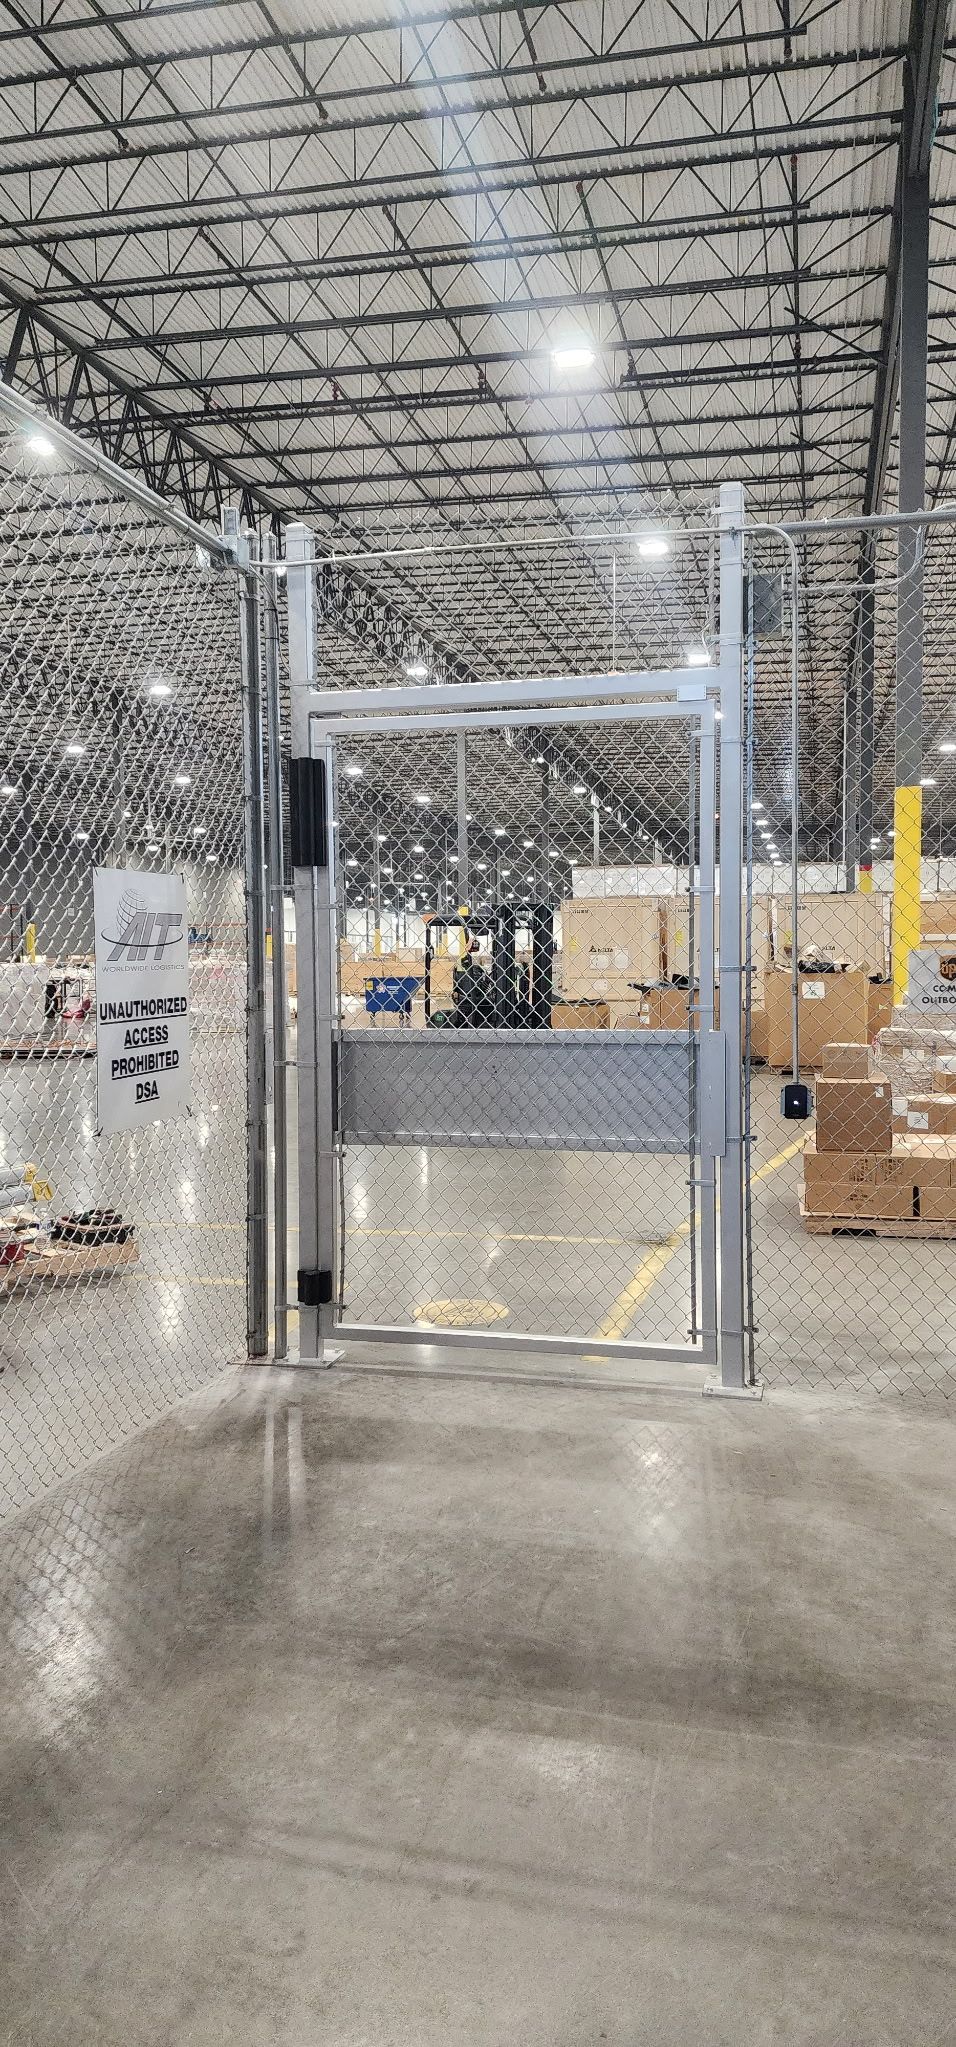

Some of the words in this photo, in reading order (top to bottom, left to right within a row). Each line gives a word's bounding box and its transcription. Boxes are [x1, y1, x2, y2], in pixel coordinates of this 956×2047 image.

[107, 912, 182, 962] AIT
[102, 965, 148, 973] WORLDWIDE
[100, 997, 187, 1021] UNAUTHORIZED
[124, 1024, 168, 1046] ACCESS
[112, 1050, 179, 1077] PROHIBITED
[136, 1080, 159, 1100] DSA
